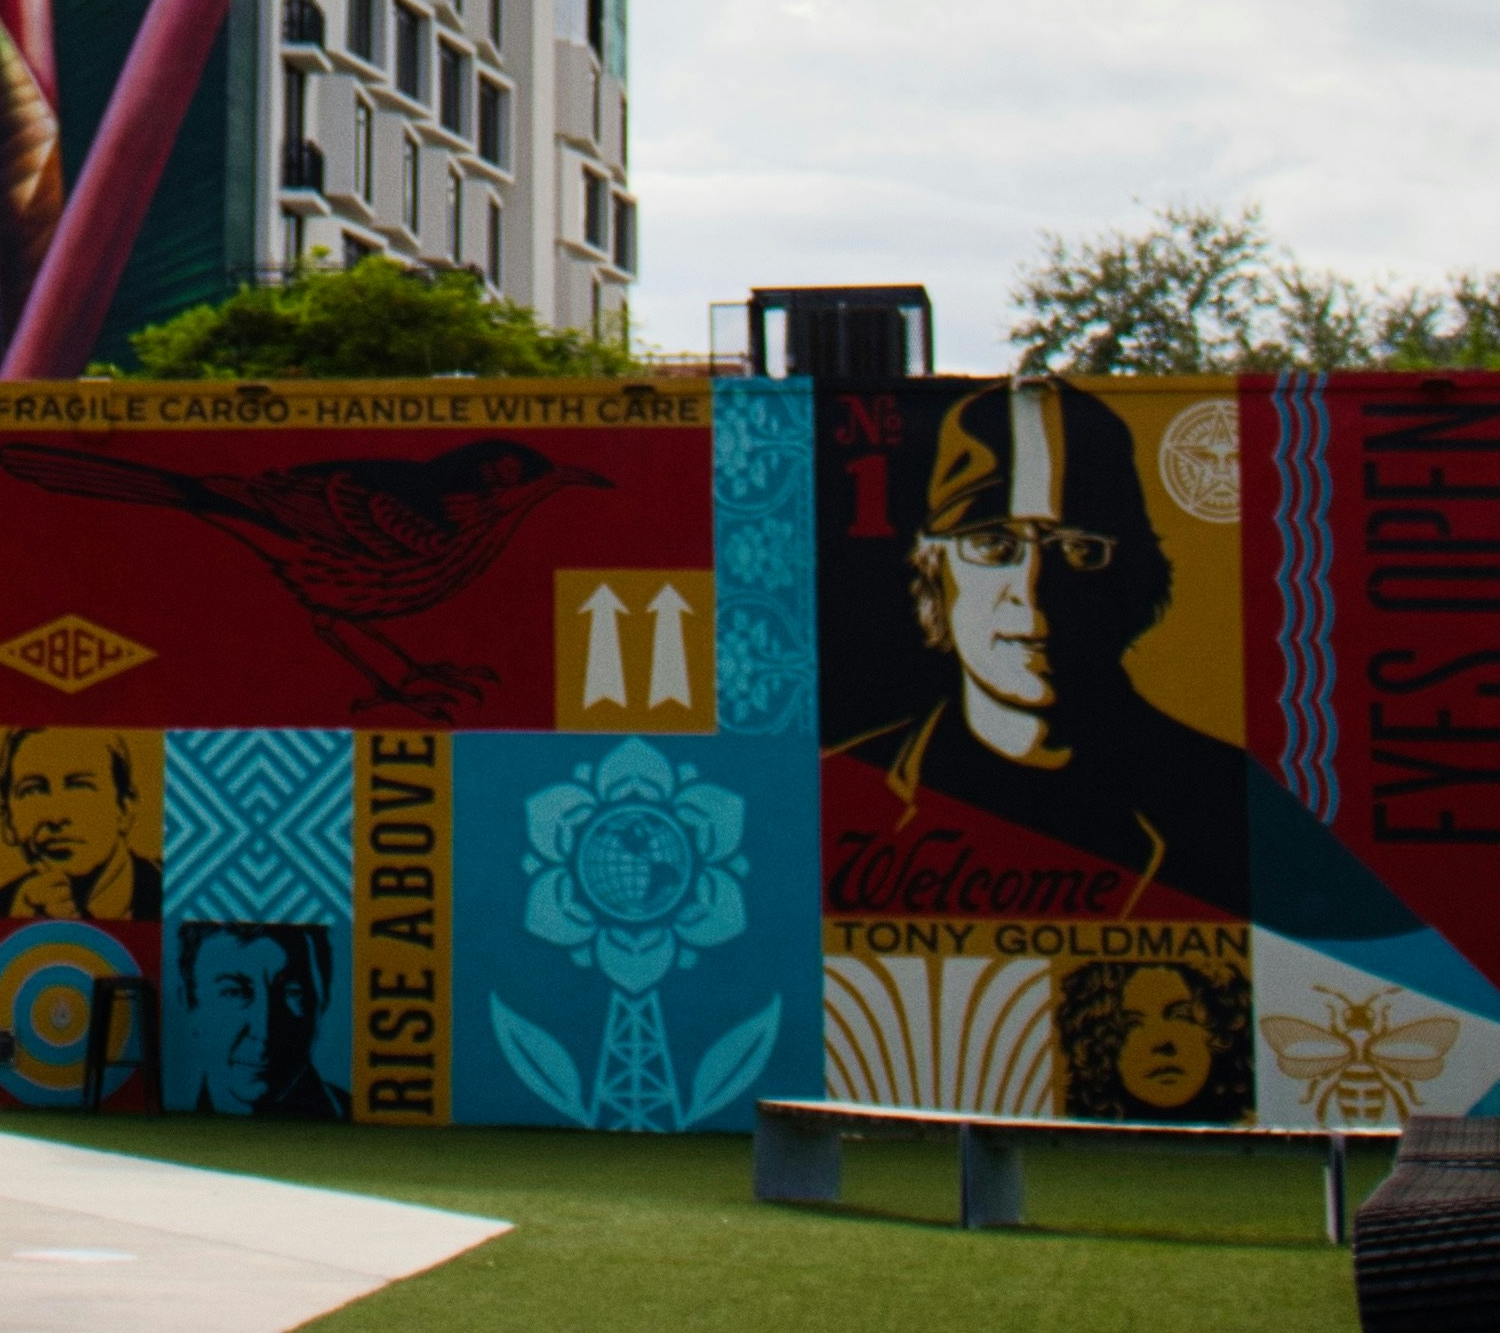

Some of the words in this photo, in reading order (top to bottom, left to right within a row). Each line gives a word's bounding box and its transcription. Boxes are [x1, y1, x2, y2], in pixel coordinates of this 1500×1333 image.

[158, 395, 291, 424] CARGO
[315, 397, 472, 424] HANDLE
[482, 396, 585, 424] WITH
[598, 396, 700, 424] CARE
[846, 452, 896, 539] 1
[20, 628, 123, 680] OBEY
[368, 732, 436, 951] ABOVE
[828, 829, 1122, 915] Welcome
[833, 921, 977, 954] TONY
[994, 923, 1249, 959] GOLDMAN
[367, 966, 436, 1118] RISE
